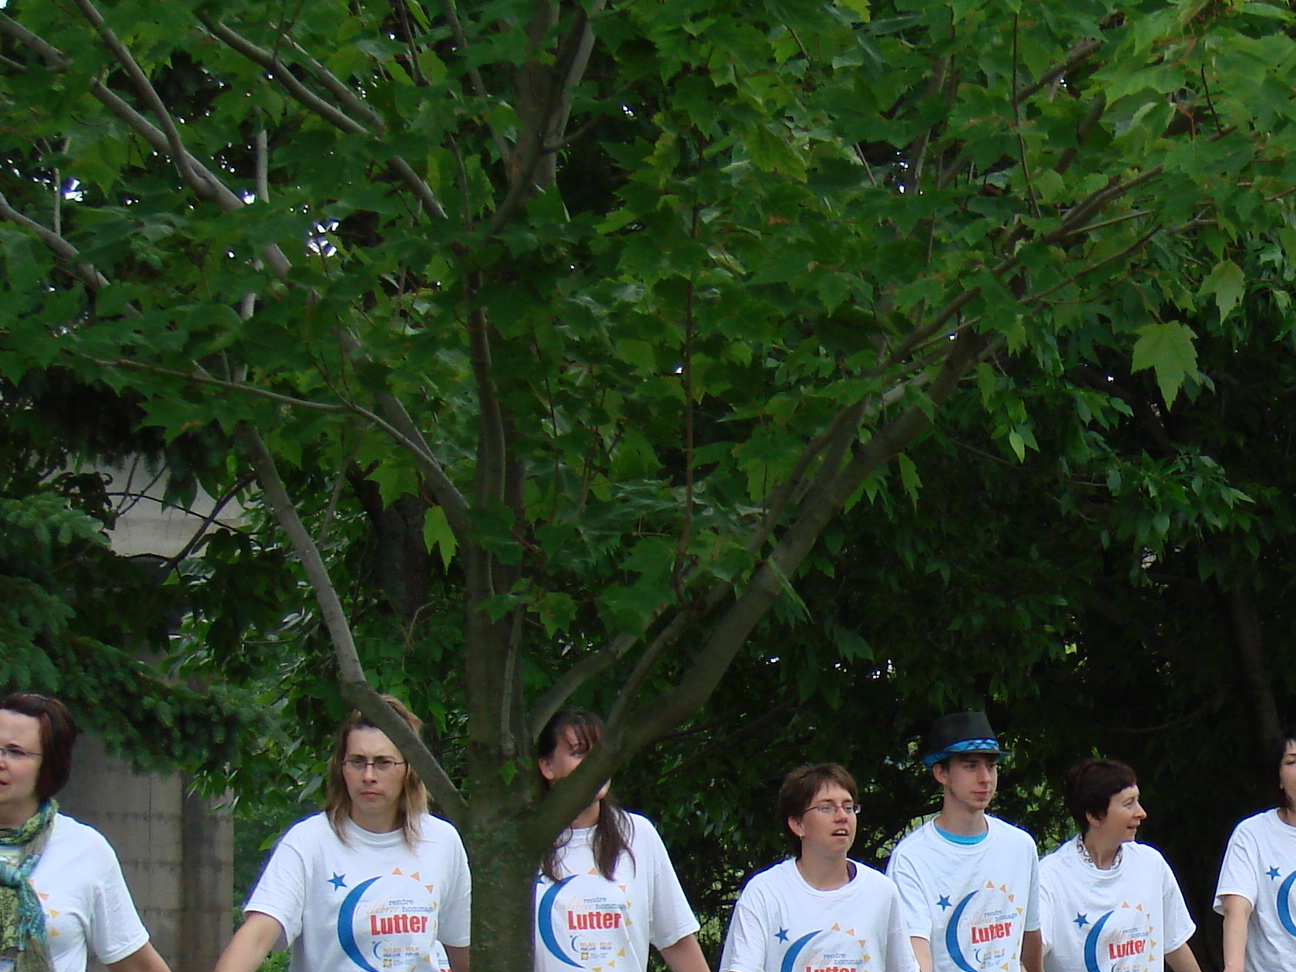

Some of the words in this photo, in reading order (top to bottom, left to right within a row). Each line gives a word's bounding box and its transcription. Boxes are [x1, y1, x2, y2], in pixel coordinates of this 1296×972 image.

[370, 914, 428, 936] Lutter
[568, 911, 621, 930] Lutter
[1108, 939, 1146, 960] Lutter
